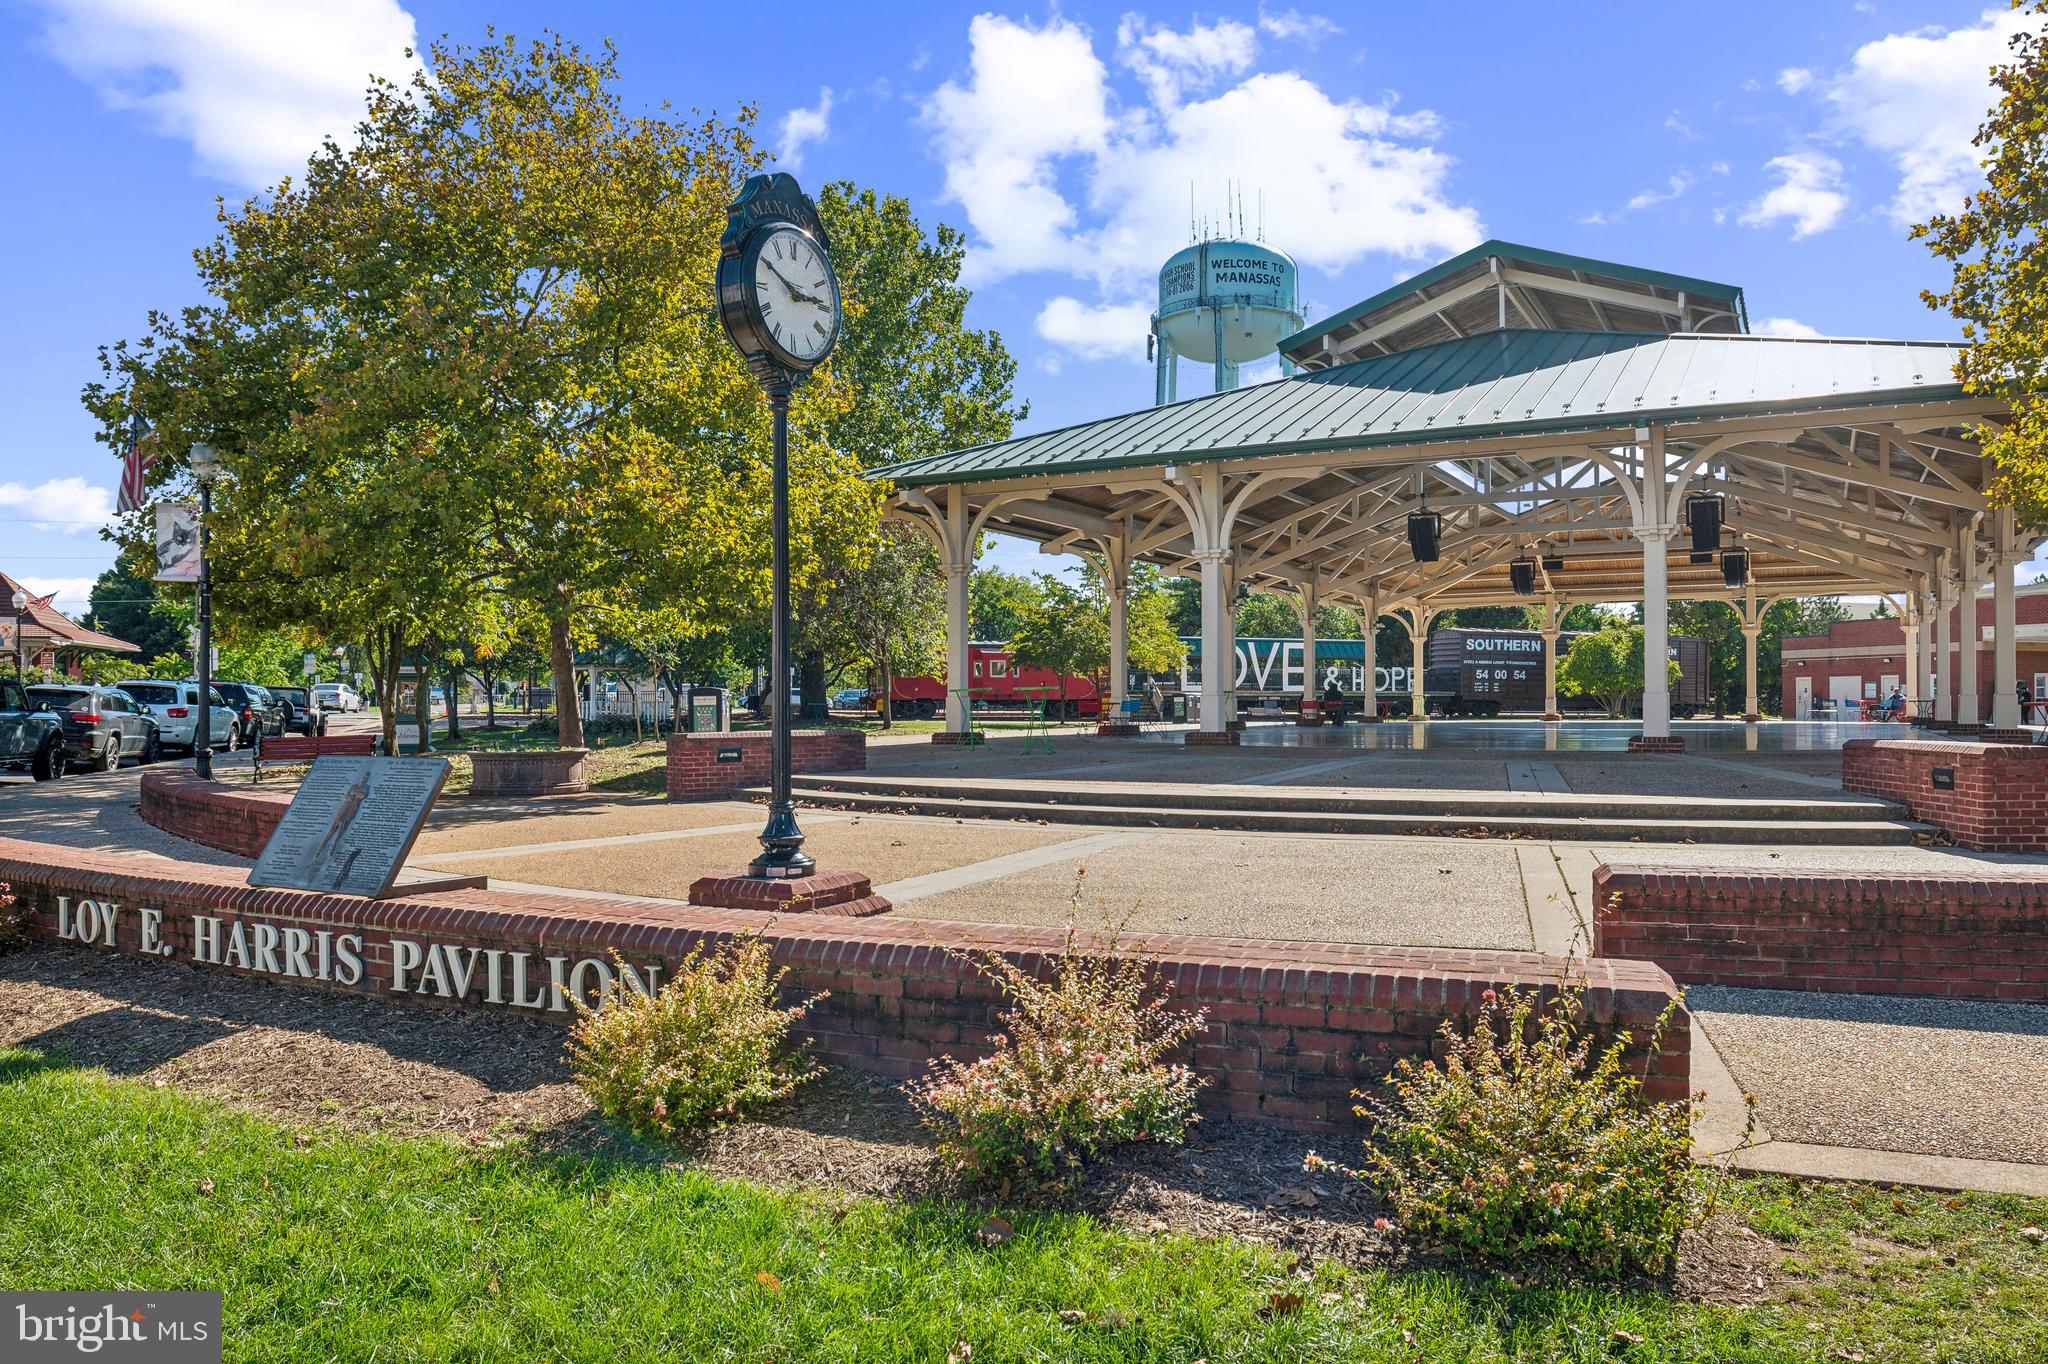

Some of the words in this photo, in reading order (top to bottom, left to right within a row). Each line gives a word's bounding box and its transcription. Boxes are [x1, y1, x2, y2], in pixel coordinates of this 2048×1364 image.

[1174, 261, 1196, 276] SCHOOL
[1211, 259, 1268, 270] WELCOME
[1272, 262, 1285, 274] TO
[1215, 272, 1281, 287] MANASSAS
[1466, 638, 1541, 652] SOUTHERN
[1180, 642, 1304, 692] LVE
[1323, 666, 1343, 692] &
[1475, 669, 1489, 679] 54
[1494, 670, 1508, 679] 00
[1513, 670, 1527, 680] 54
[56, 896, 122, 947] LOY
[138, 908, 173, 957] E.
[191, 914, 363, 986] HARRIS
[388, 939, 663, 1013] PAVILION
